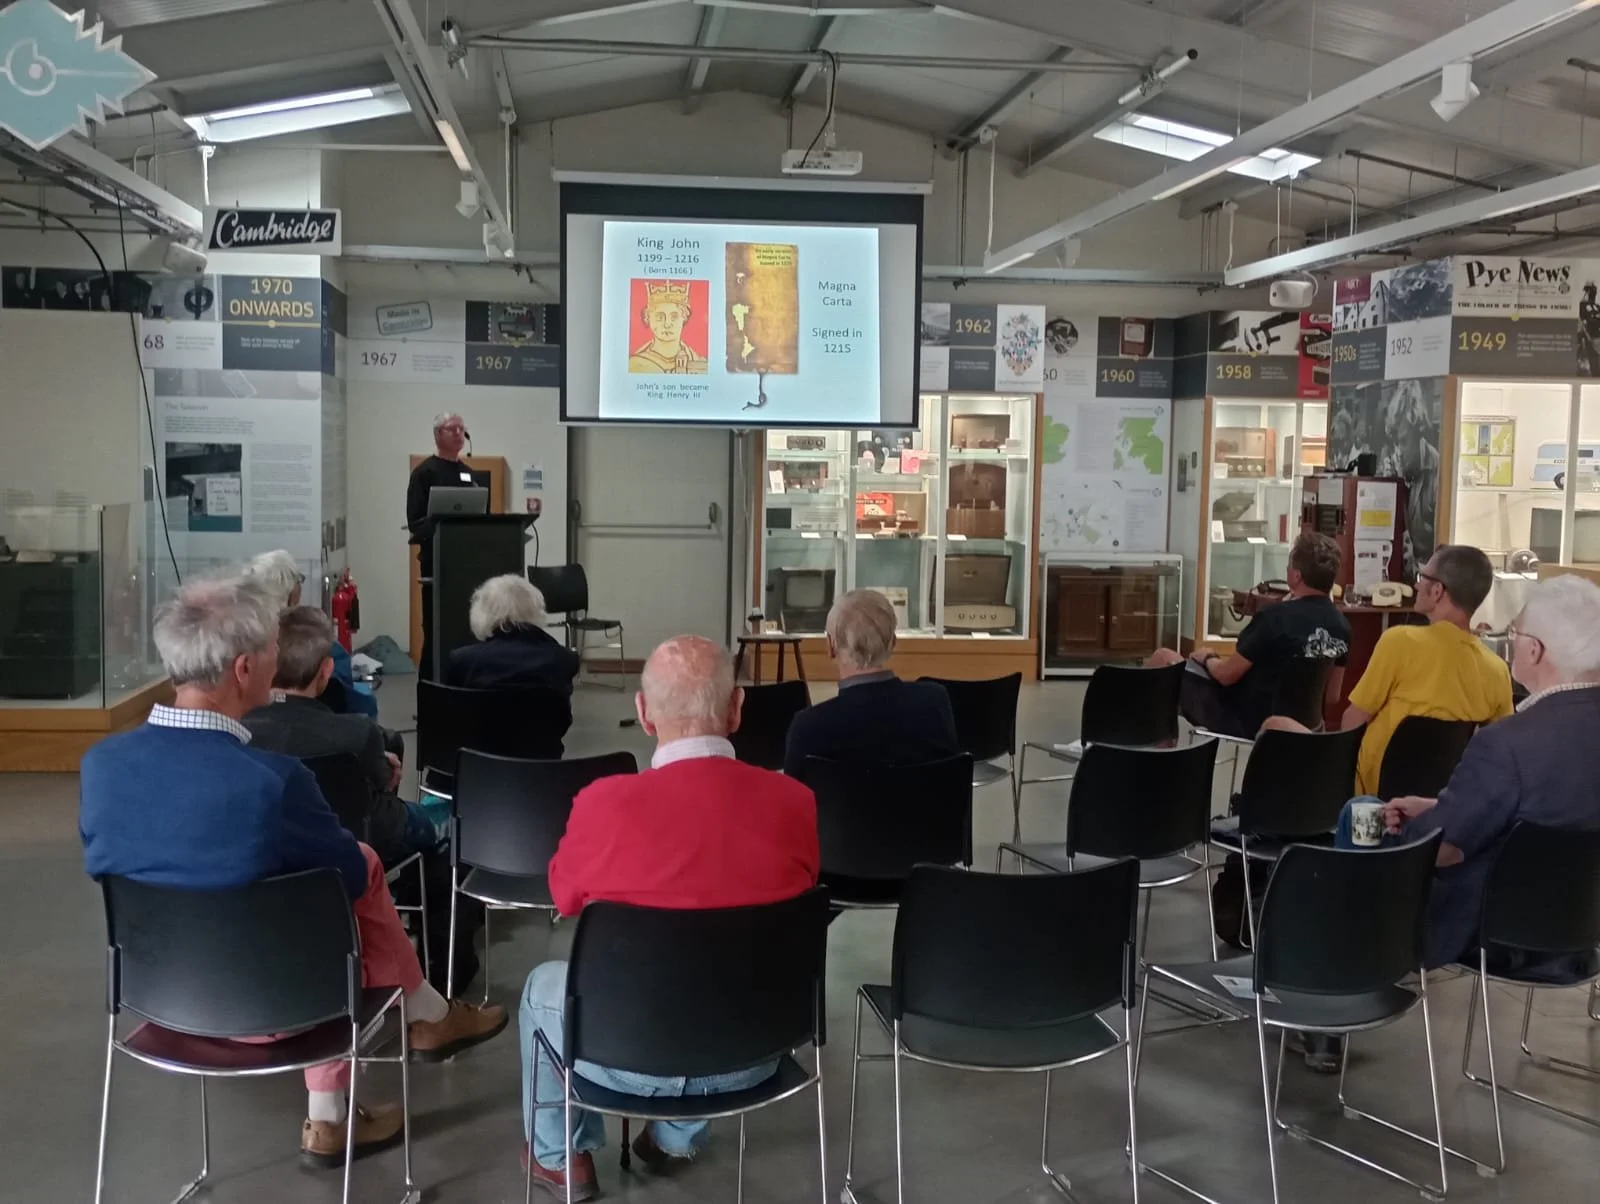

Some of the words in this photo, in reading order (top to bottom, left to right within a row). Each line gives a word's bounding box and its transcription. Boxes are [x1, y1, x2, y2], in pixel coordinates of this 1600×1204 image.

[216, 211, 332, 248] Cambridge
[637, 237, 664, 250] King
[671, 238, 700, 249] John
[637, 254, 663, 263] 1199
[675, 254, 700, 263] 1216
[1464, 260, 1511, 288] Pye
[1517, 258, 1571, 284] News
[251, 278, 293, 295] 1970
[818, 281, 856, 293] Magna
[229, 299, 314, 318] ONWARDS
[822, 297, 852, 306] Carta
[812, 327, 849, 339] Signed
[852, 328, 863, 338] in
[955, 318, 992, 334] 1962
[824, 344, 851, 353] 1215
[1391, 337, 1413, 356] 1952
[1458, 331, 1506, 351] 1949
[361, 351, 397, 366] 1967
[1333, 346, 1357, 363] 1950s
[476, 356, 512, 371] 1967
[1101, 369, 1135, 383] 1960
[1216, 364, 1252, 380] 1958
[680, 383, 709, 391] became
[647, 392, 664, 400] King
[667, 391, 689, 400] Henry
